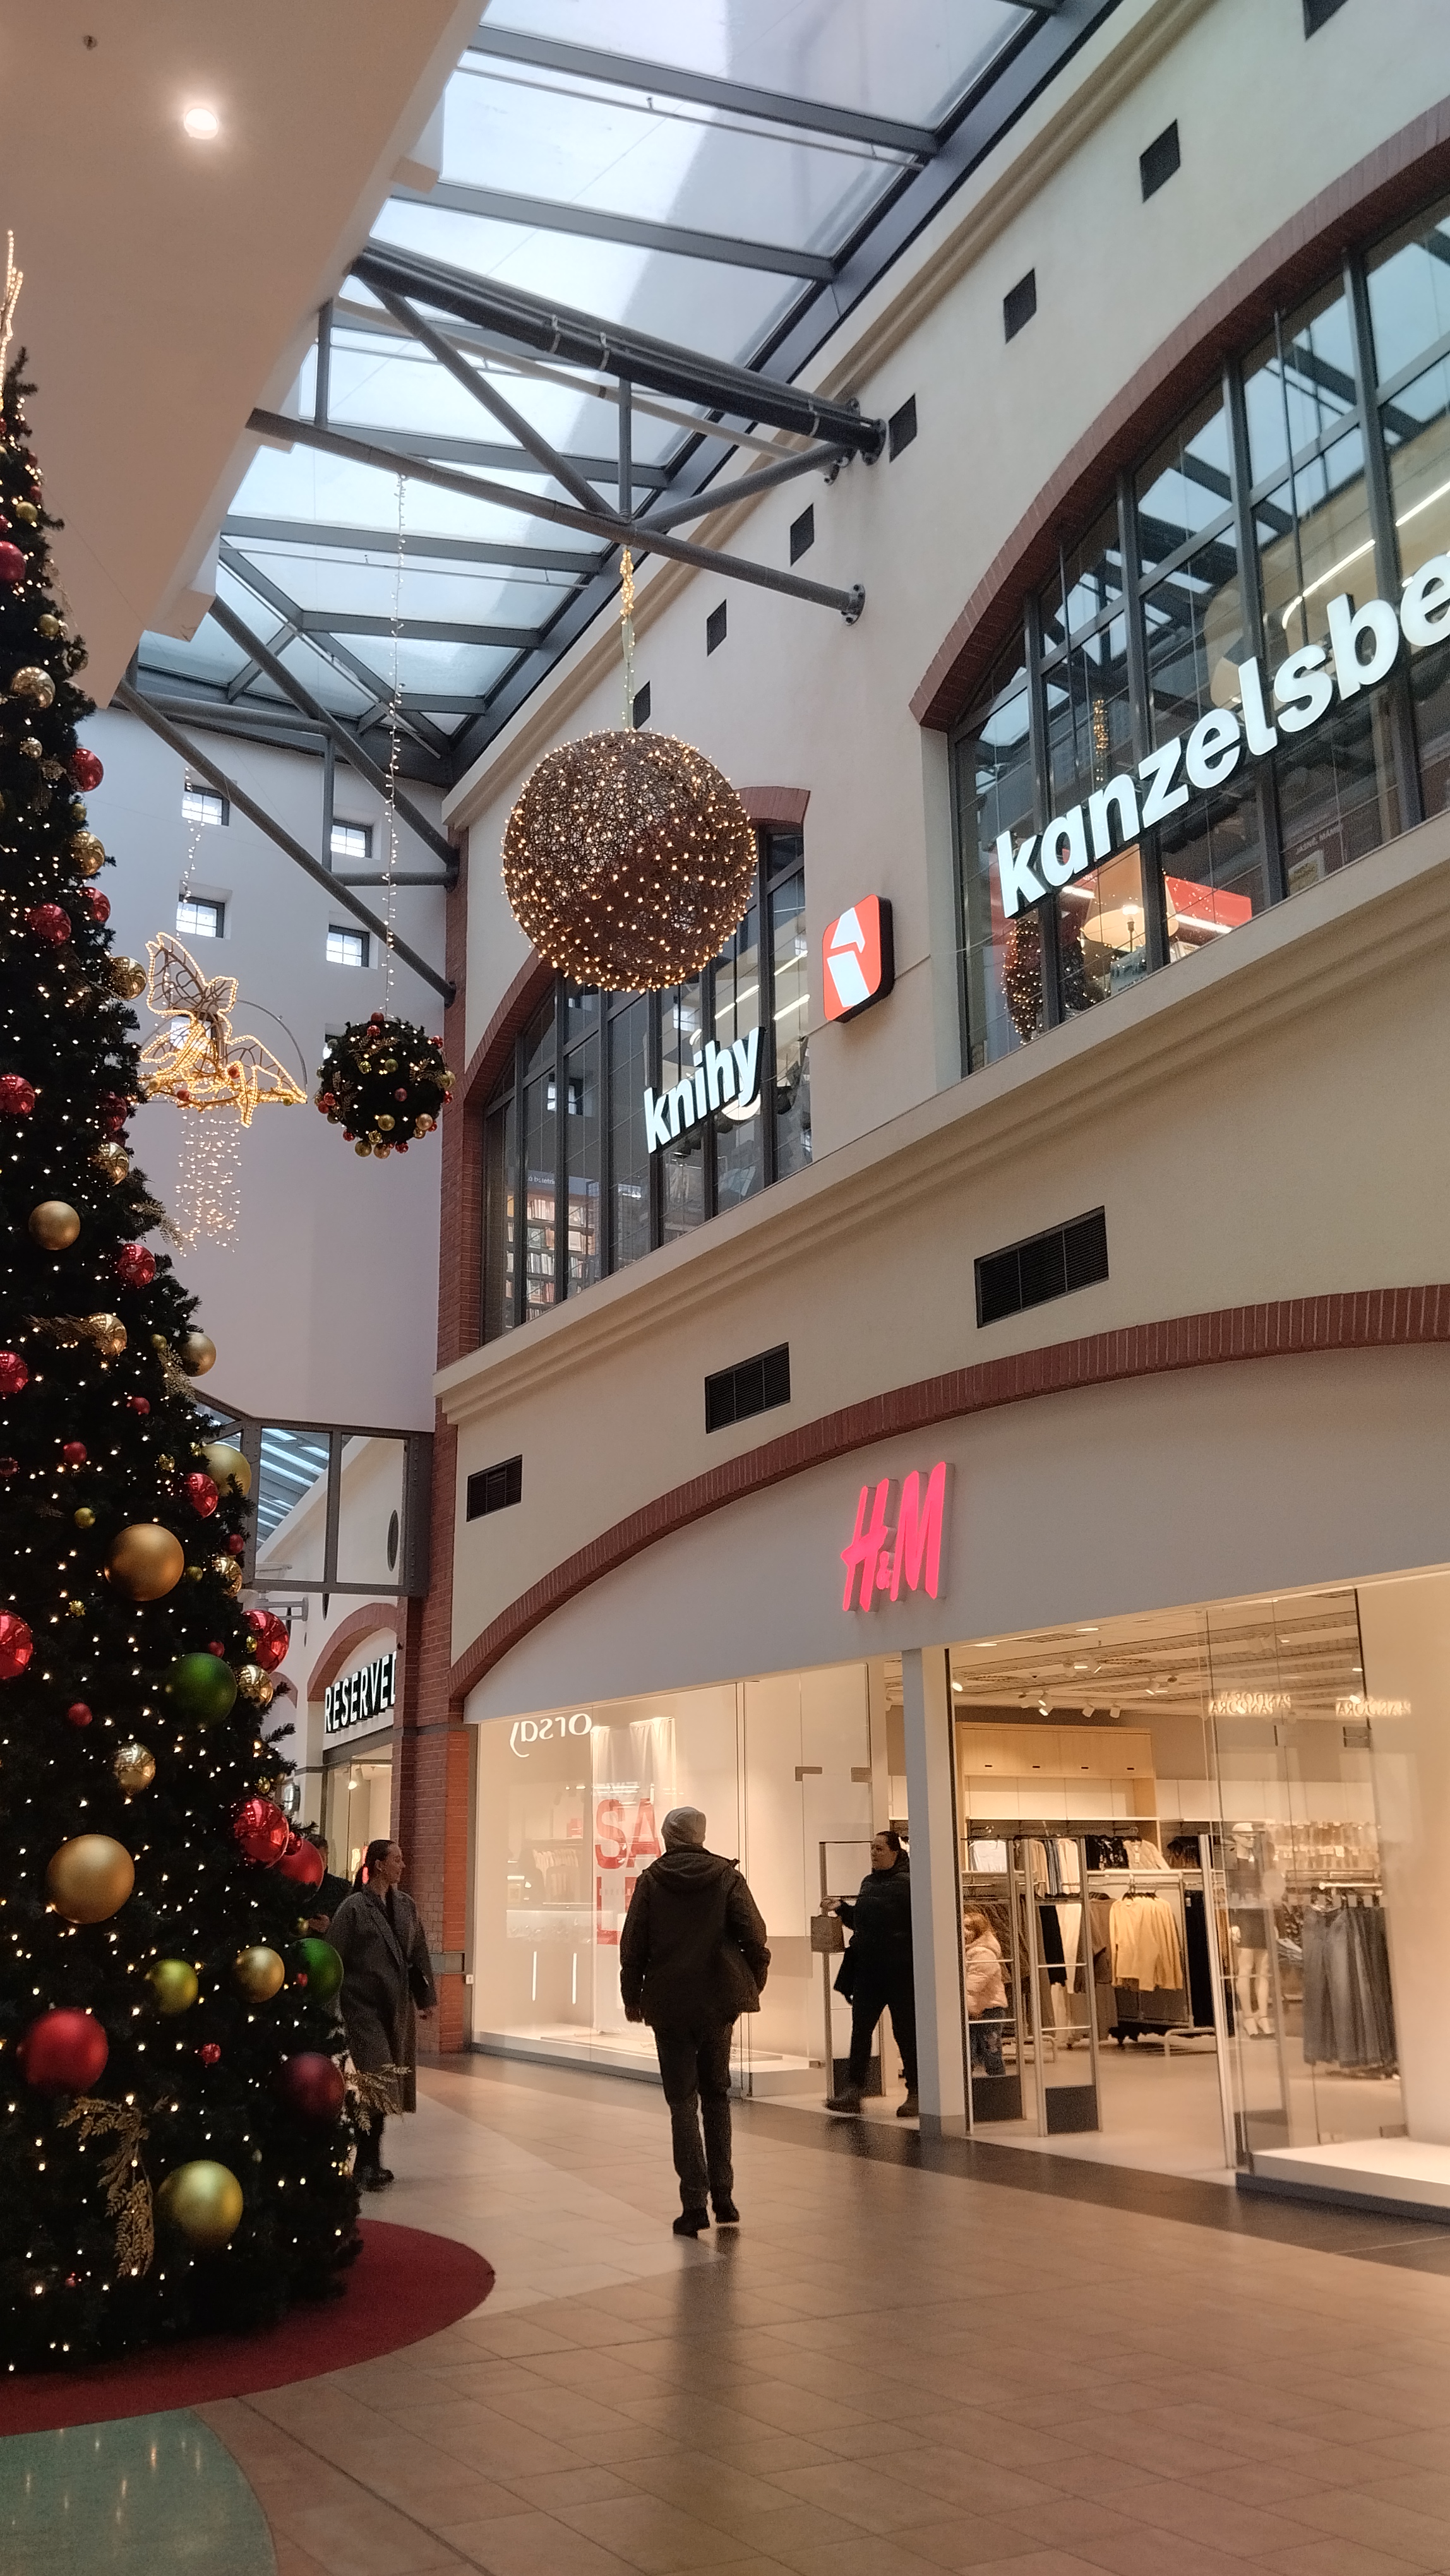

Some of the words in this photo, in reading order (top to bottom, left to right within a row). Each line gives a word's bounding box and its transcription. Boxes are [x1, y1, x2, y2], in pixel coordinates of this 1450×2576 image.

[996, 554, 1450, 919] kanzelsbe
[644, 1027, 759, 1154] knihy
[841, 1461, 946, 1613] H&M
